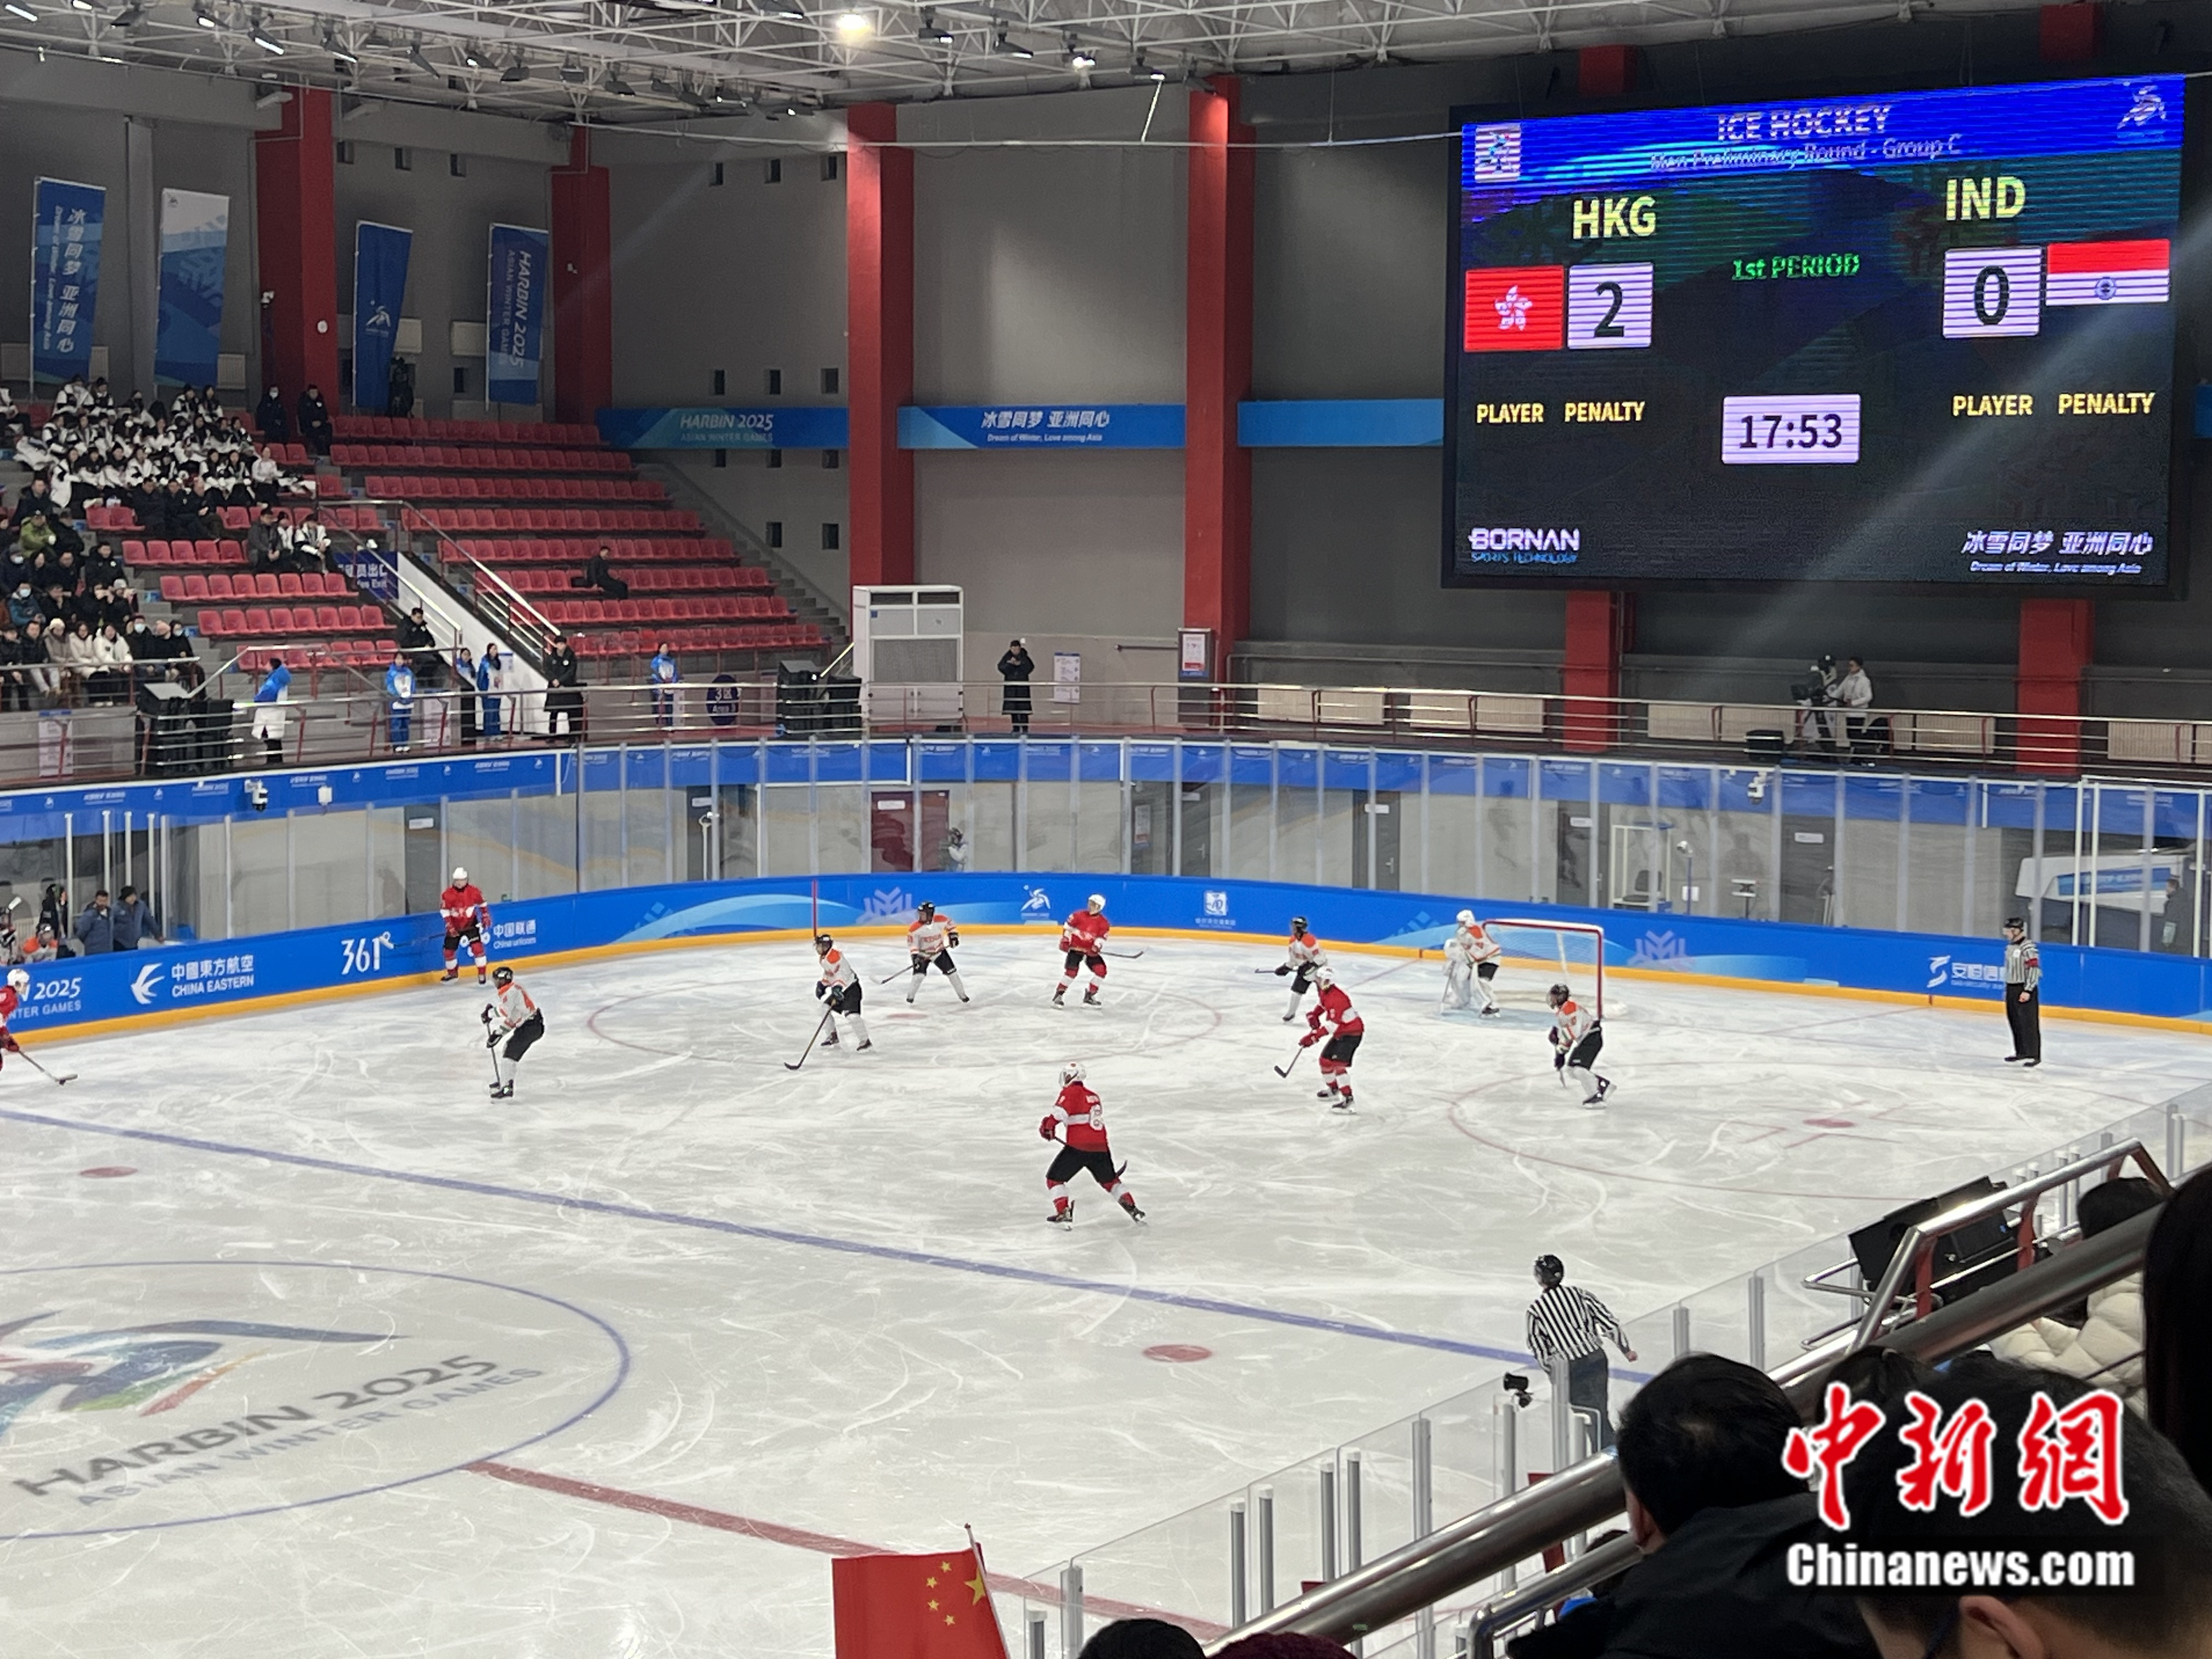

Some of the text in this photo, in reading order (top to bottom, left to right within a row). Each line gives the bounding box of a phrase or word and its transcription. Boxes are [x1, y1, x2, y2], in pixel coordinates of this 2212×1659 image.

[1717, 104, 1891, 141] ICE HOCKEY
[1804, 140, 1866, 161] Round
[1883, 137, 1943, 160] Group
[1949, 133, 1962, 155] C
[1946, 176, 2027, 221] IND
[1572, 196, 1657, 240] HKG
[1732, 254, 1860, 281] 1st PERIOD
[1594, 281, 1625, 337] 2
[1974, 265, 2010, 325] 0
[57, 284, 80, 353] 亚洲同心
[510, 250, 532, 369] HARBIN 2025
[1476, 401, 1645, 424] PLAYER PENALTY
[1952, 392, 2155, 416] PLAYER PENALTY
[680, 414, 775, 431] HARBIN 2025
[980, 410, 1110, 429] 冰雪同梦 亚洲同心
[1739, 413, 1842, 449] 17:53
[1468, 527, 1580, 551] BORNAN
[1961, 530, 2154, 556] 冰雪同梦 亚洲同心
[171, 954, 254, 982] 中國東方航空
[33, 977, 82, 1001] 2025
[171, 974, 255, 998] CHINA EASTERN
[42, 999, 82, 1015] GAMES
[13, 1355, 498, 1498] HARBIN 2025
[77, 1367, 546, 1507] ASIAN WINTER GAMES
